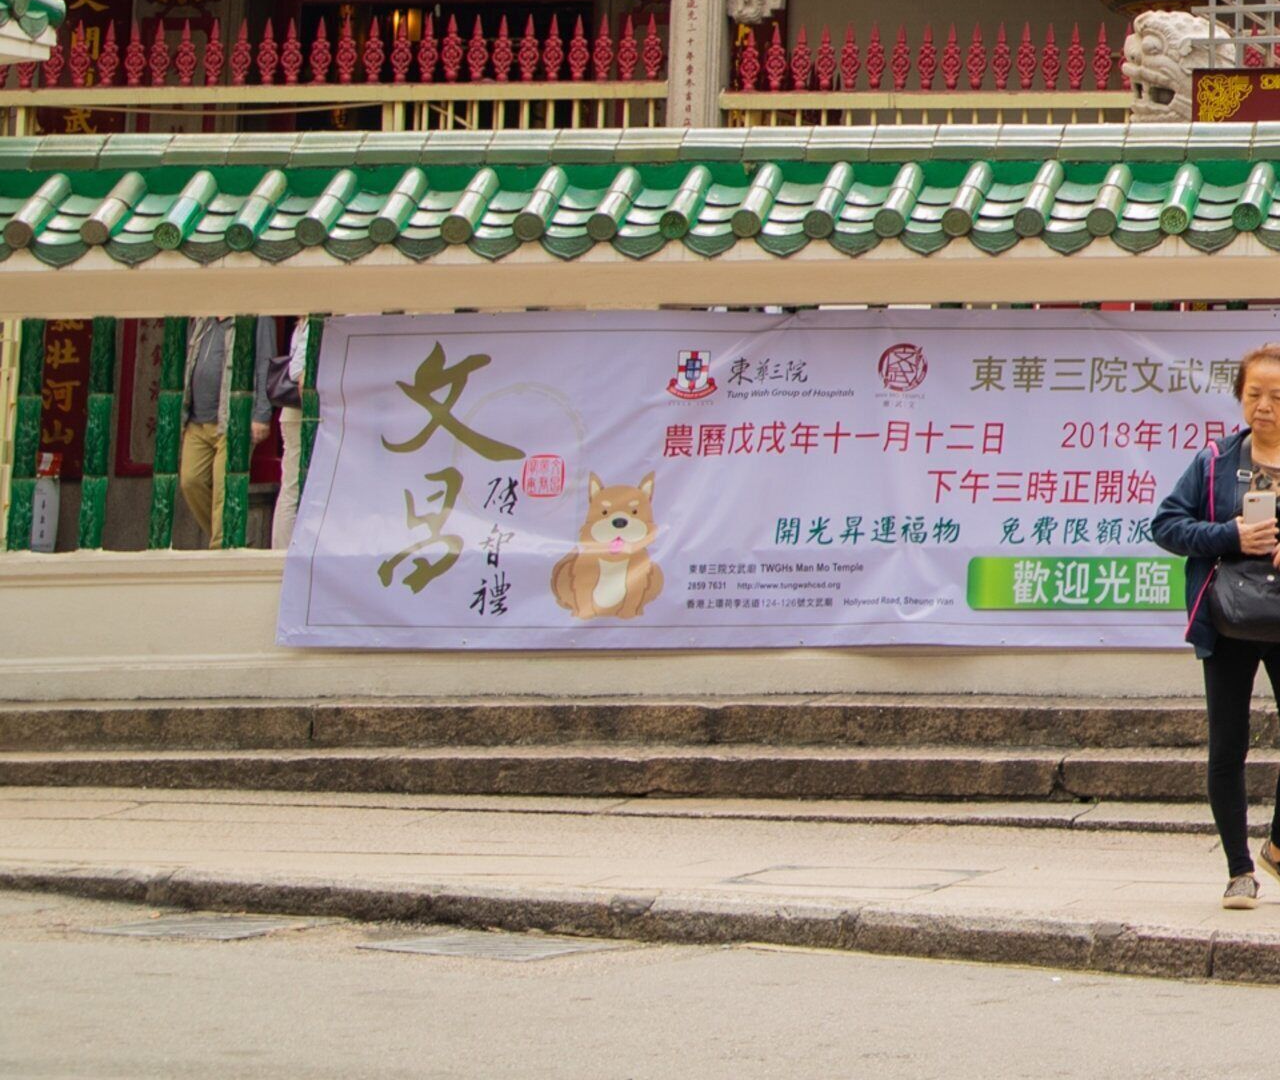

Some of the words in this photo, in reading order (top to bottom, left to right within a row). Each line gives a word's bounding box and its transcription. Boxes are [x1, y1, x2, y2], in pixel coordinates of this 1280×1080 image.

[727, 357, 809, 385] 東華三院
[727, 390, 749, 401] Tung
[750, 389, 770, 398] Wah
[771, 389, 800, 400] Group
[801, 388, 812, 398] of
[812, 388, 855, 400] Hospitals
[663, 420, 1005, 458] 農曆戊戌年十一月十二日
[377, 341, 527, 595] 文昌
[927, 469, 1157, 505] 下午三時正開始
[775, 515, 961, 545] 開光昇運福物
[689, 564, 757, 575] 東華三院文武廟
[760, 563, 793, 573] TWGHs
[796, 563, 814, 573] Man
[816, 563, 830, 573] Mo
[833, 562, 864, 574] Temple
[1012, 560, 1172, 605] 歡迎光臨
[687, 582, 707, 591] 2859
[709, 581, 727, 590] 7631
[843, 597, 880, 608] Hollywood
